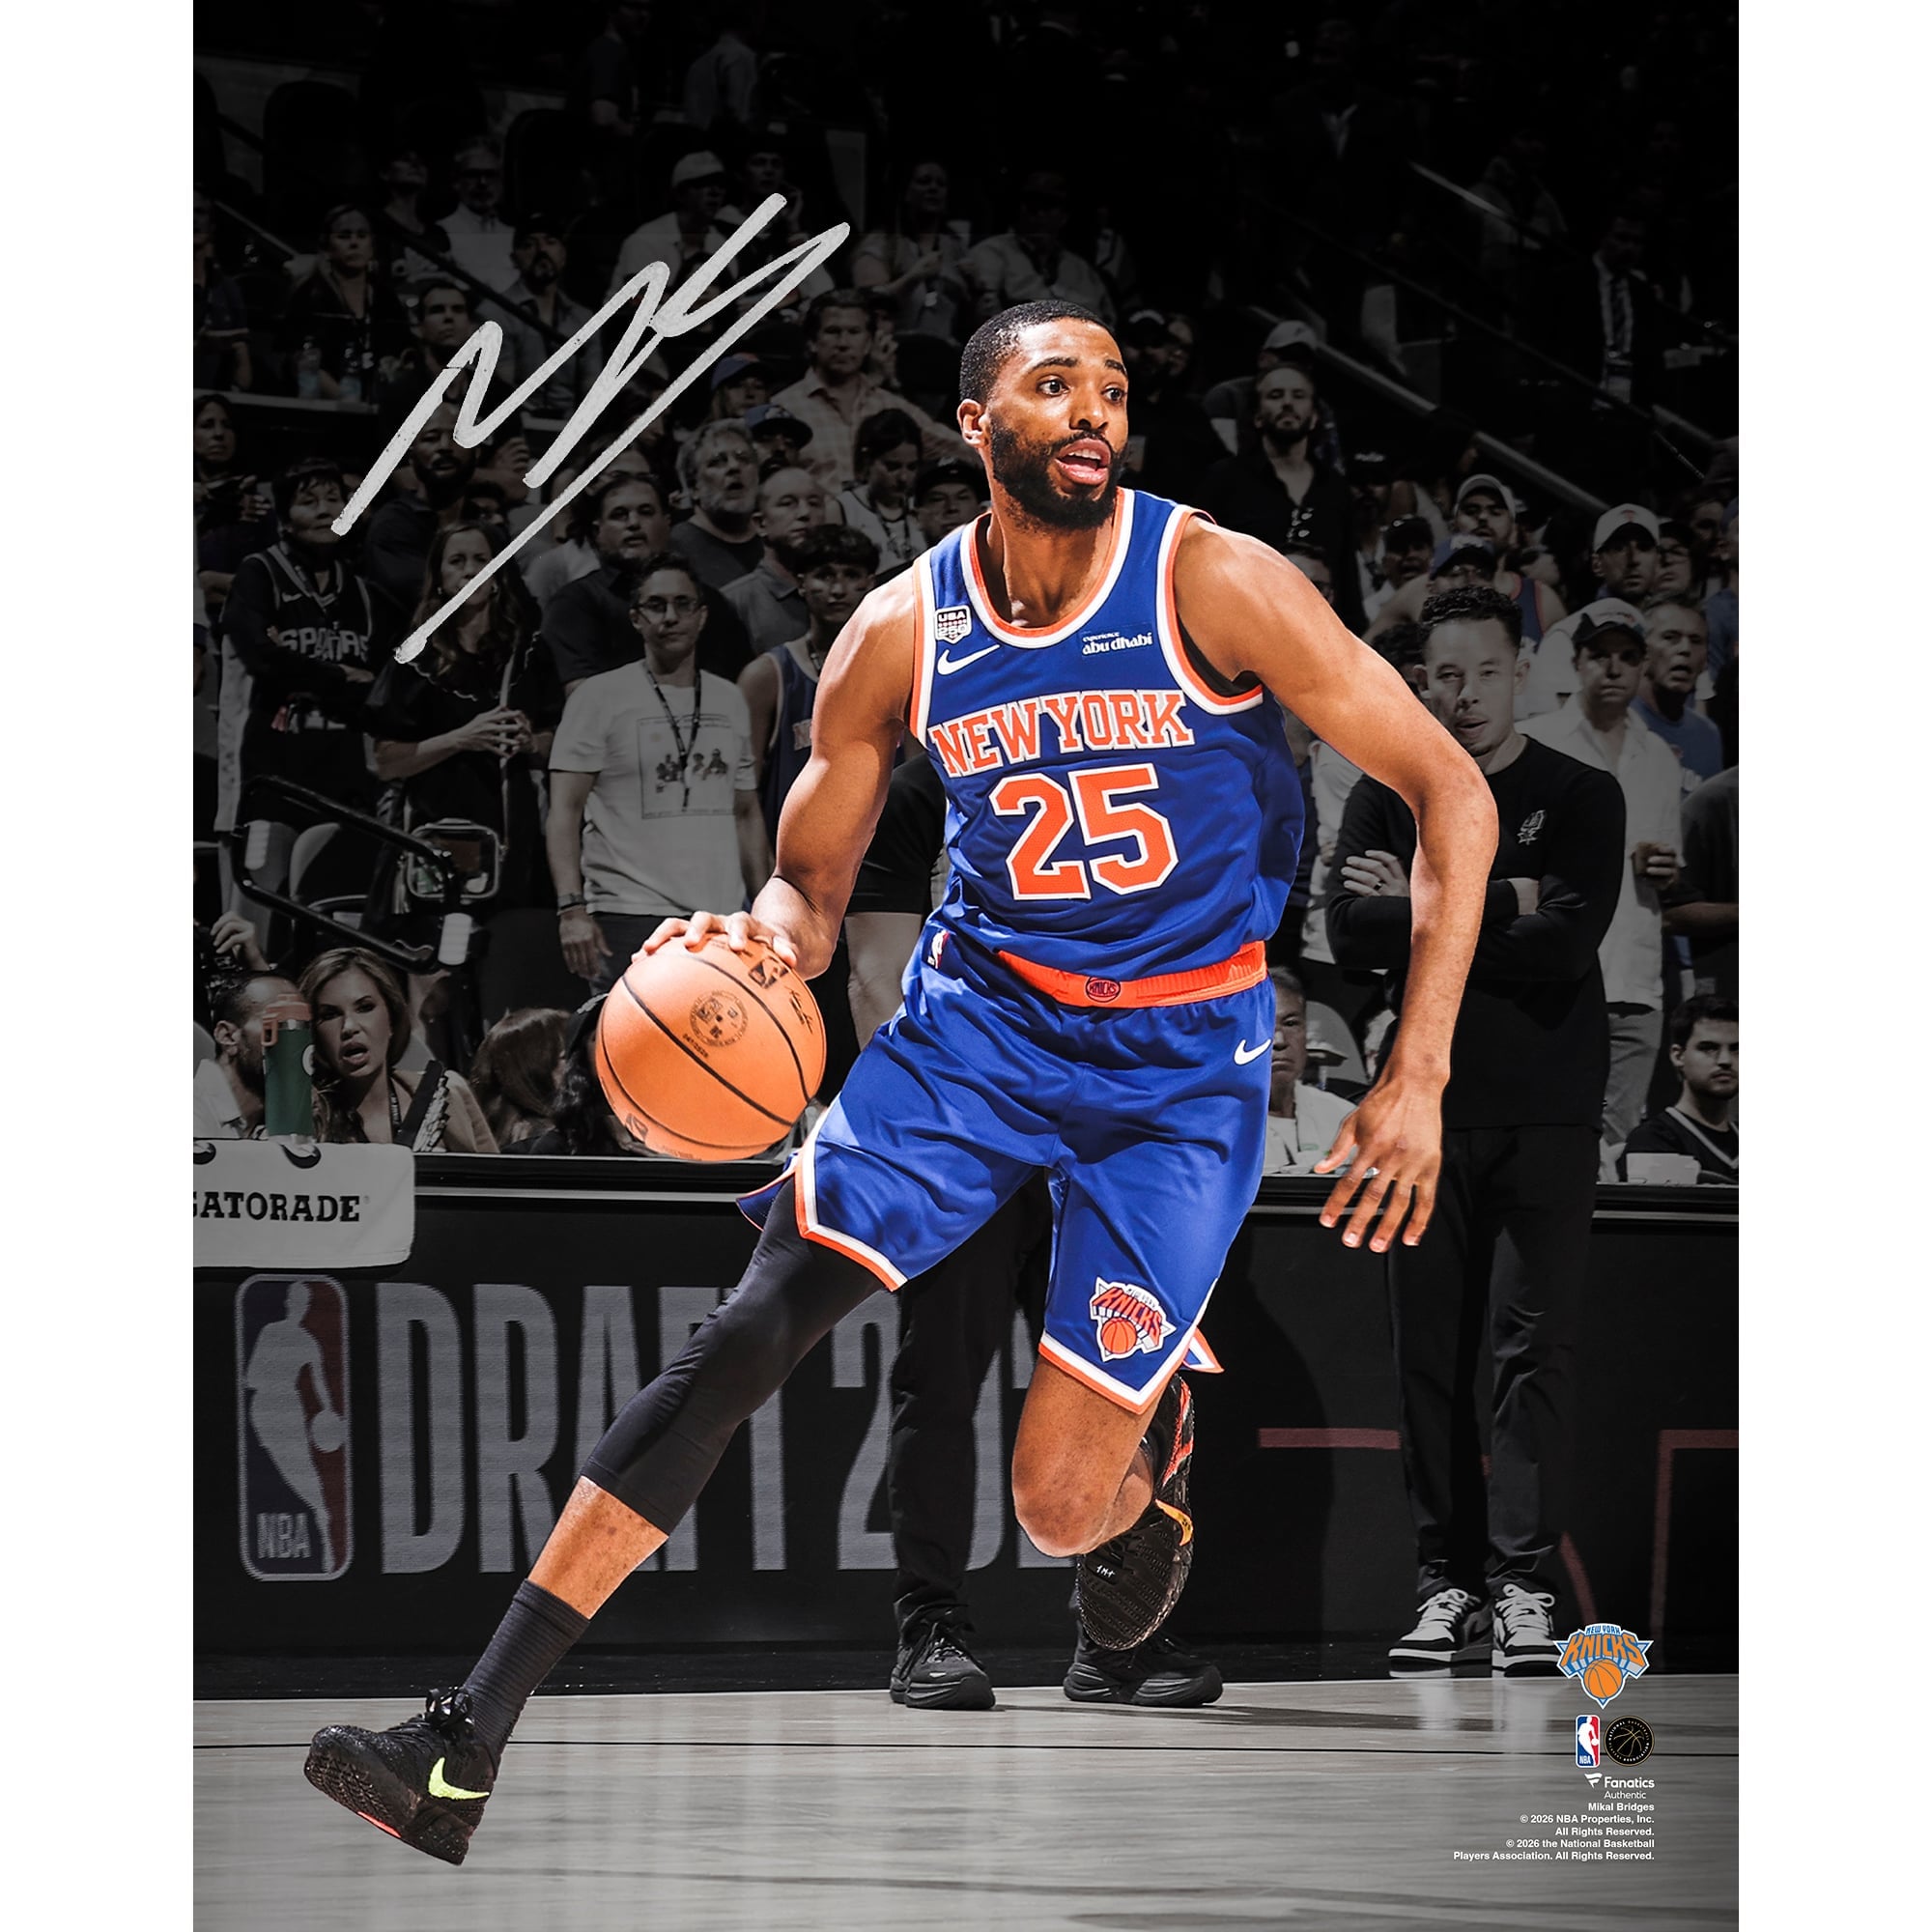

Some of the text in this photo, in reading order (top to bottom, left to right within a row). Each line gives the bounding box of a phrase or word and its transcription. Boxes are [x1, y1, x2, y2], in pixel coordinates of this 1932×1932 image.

[938, 611, 966, 622] USA
[1082, 632, 1153, 655] abu dhabi
[928, 689, 1196, 779] NEW YORK
[988, 762, 1179, 900] 25
[193, 1191, 360, 1223] ATORADE
[1092, 1287, 1163, 1348] KNICKS
[256, 1512, 311, 1559] NBA
